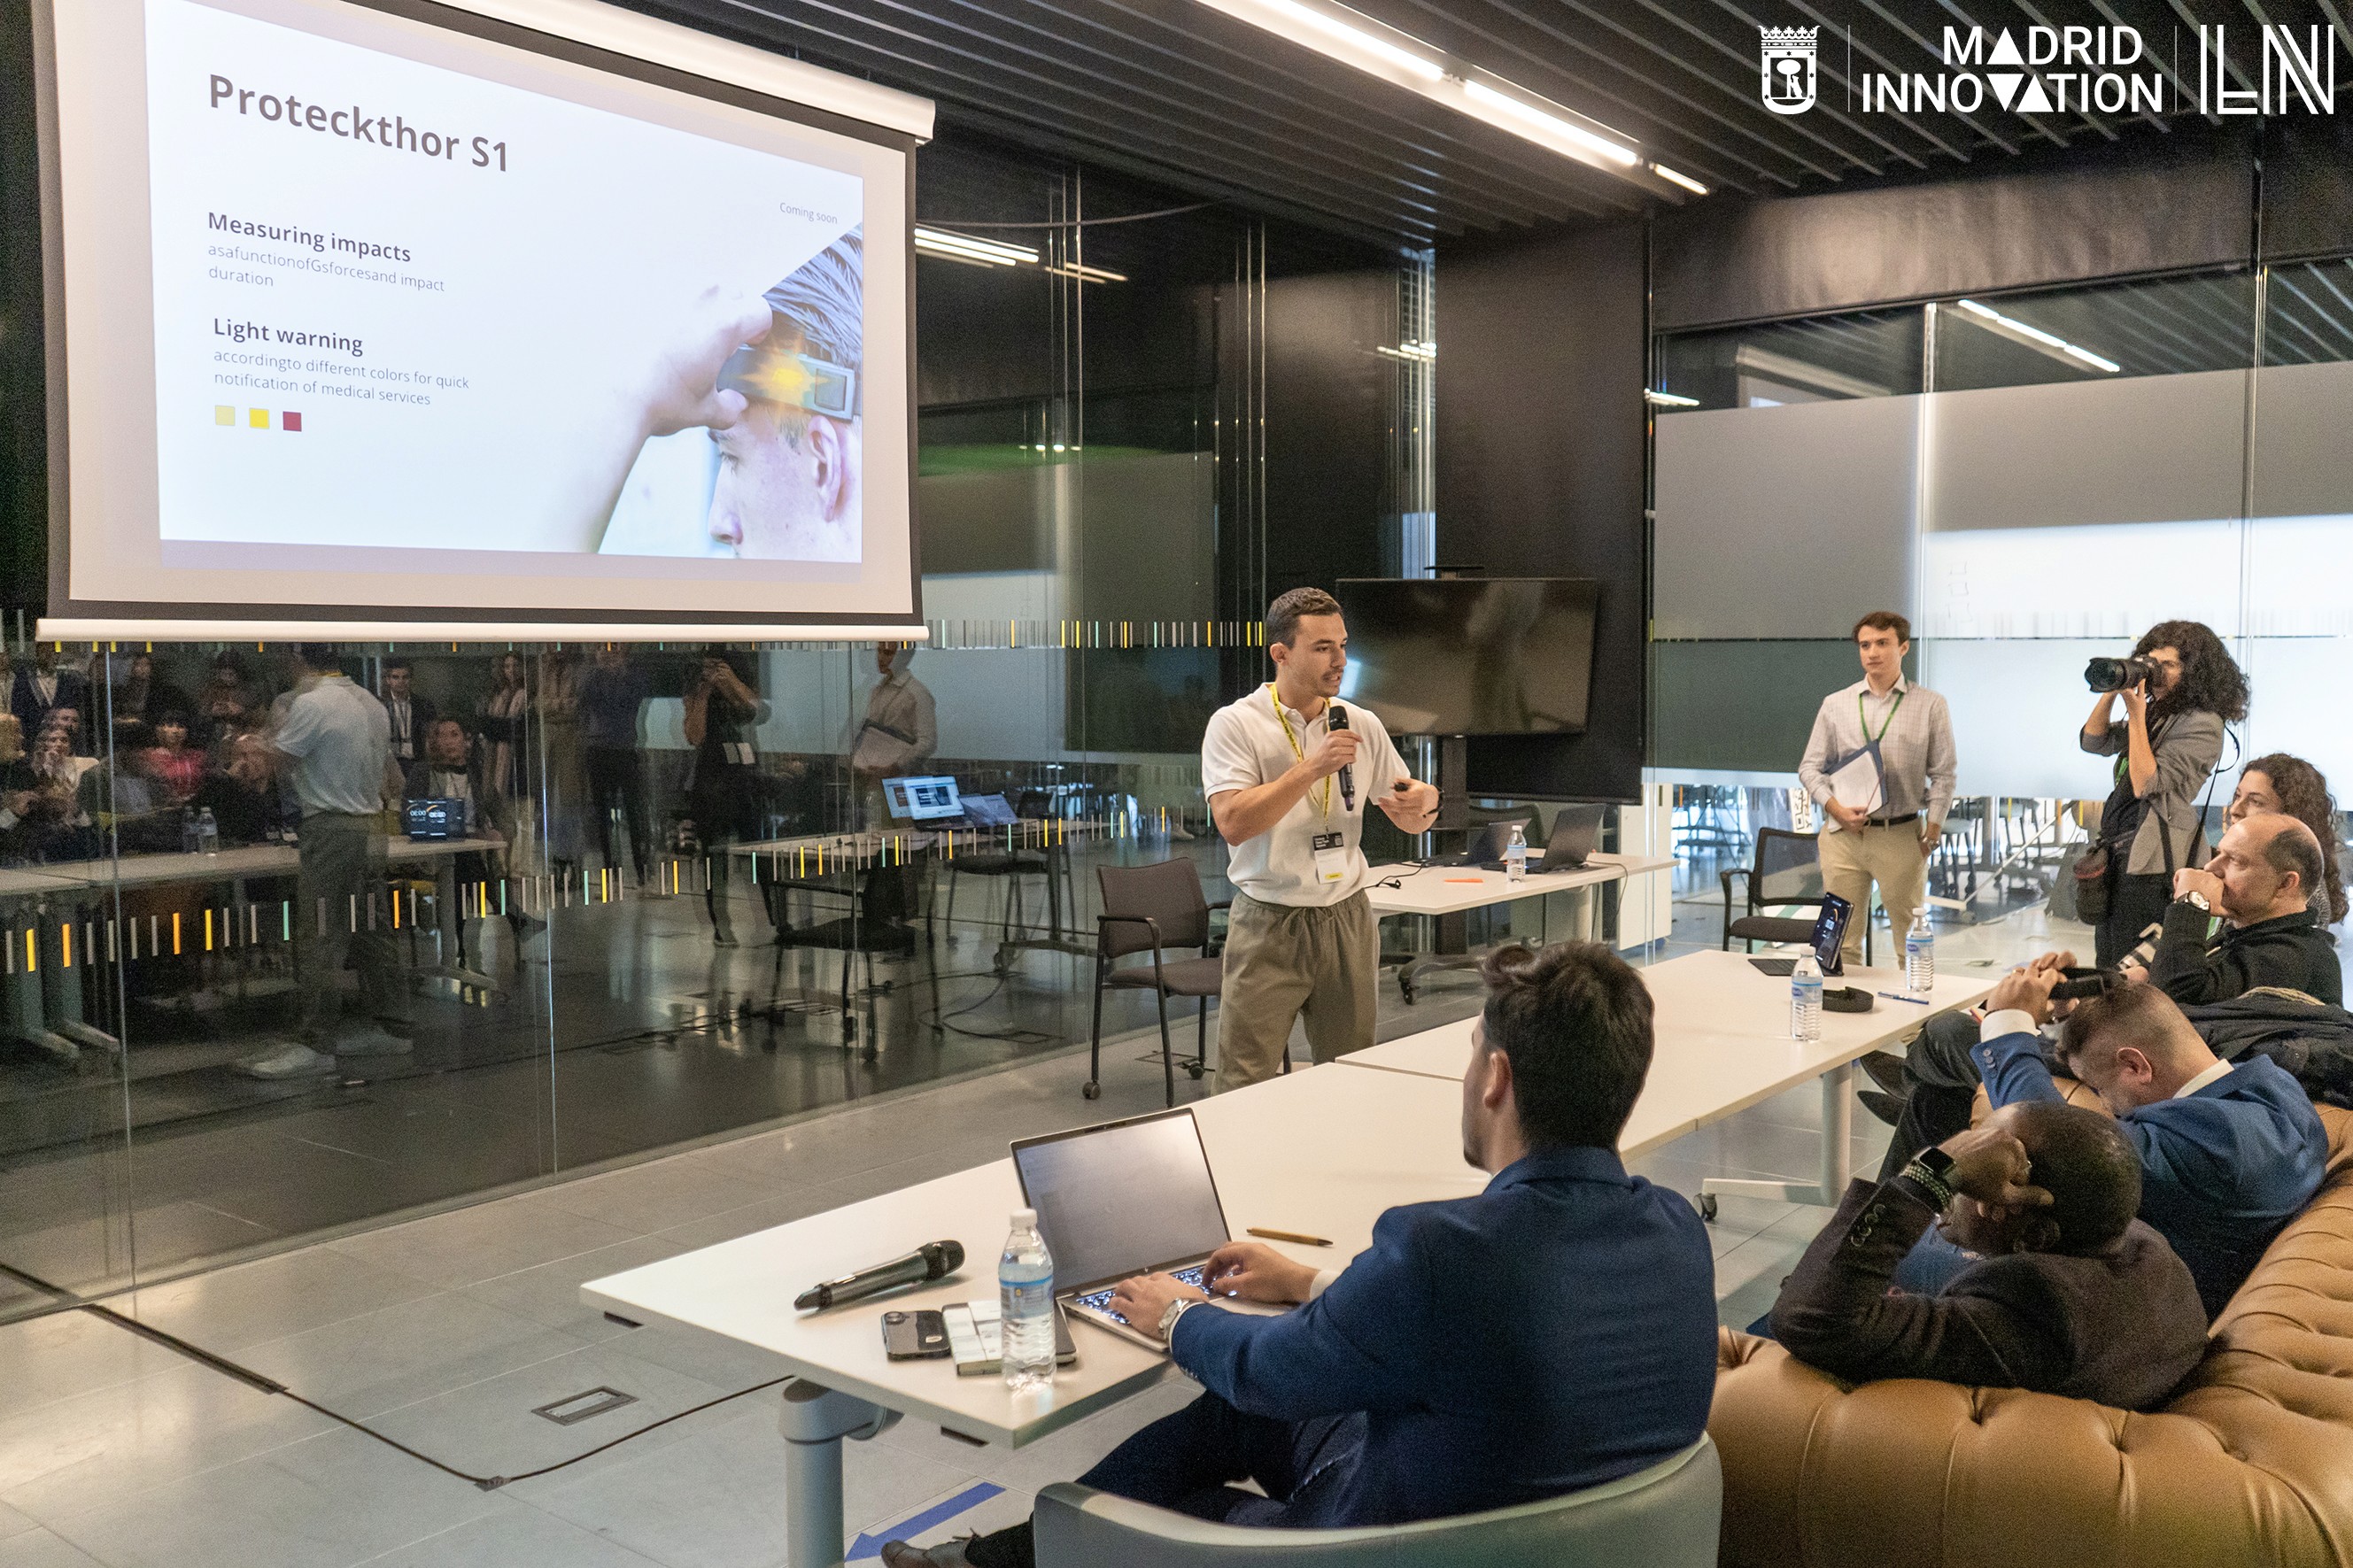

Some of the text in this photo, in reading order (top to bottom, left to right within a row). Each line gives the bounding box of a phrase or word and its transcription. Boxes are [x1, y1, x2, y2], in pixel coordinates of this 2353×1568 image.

[209, 73, 507, 172] Proteckthor S1
[779, 202, 838, 224] Coming soon
[208, 212, 411, 262] Measuring impacts
[208, 266, 275, 287] duration
[400, 273, 445, 292] impact
[213, 318, 364, 357] Light warning
[214, 372, 431, 406] notification of medical services
[306, 359, 366, 378] different
[370, 367, 410, 382] colors
[414, 371, 432, 385] for
[436, 375, 470, 390] quick
